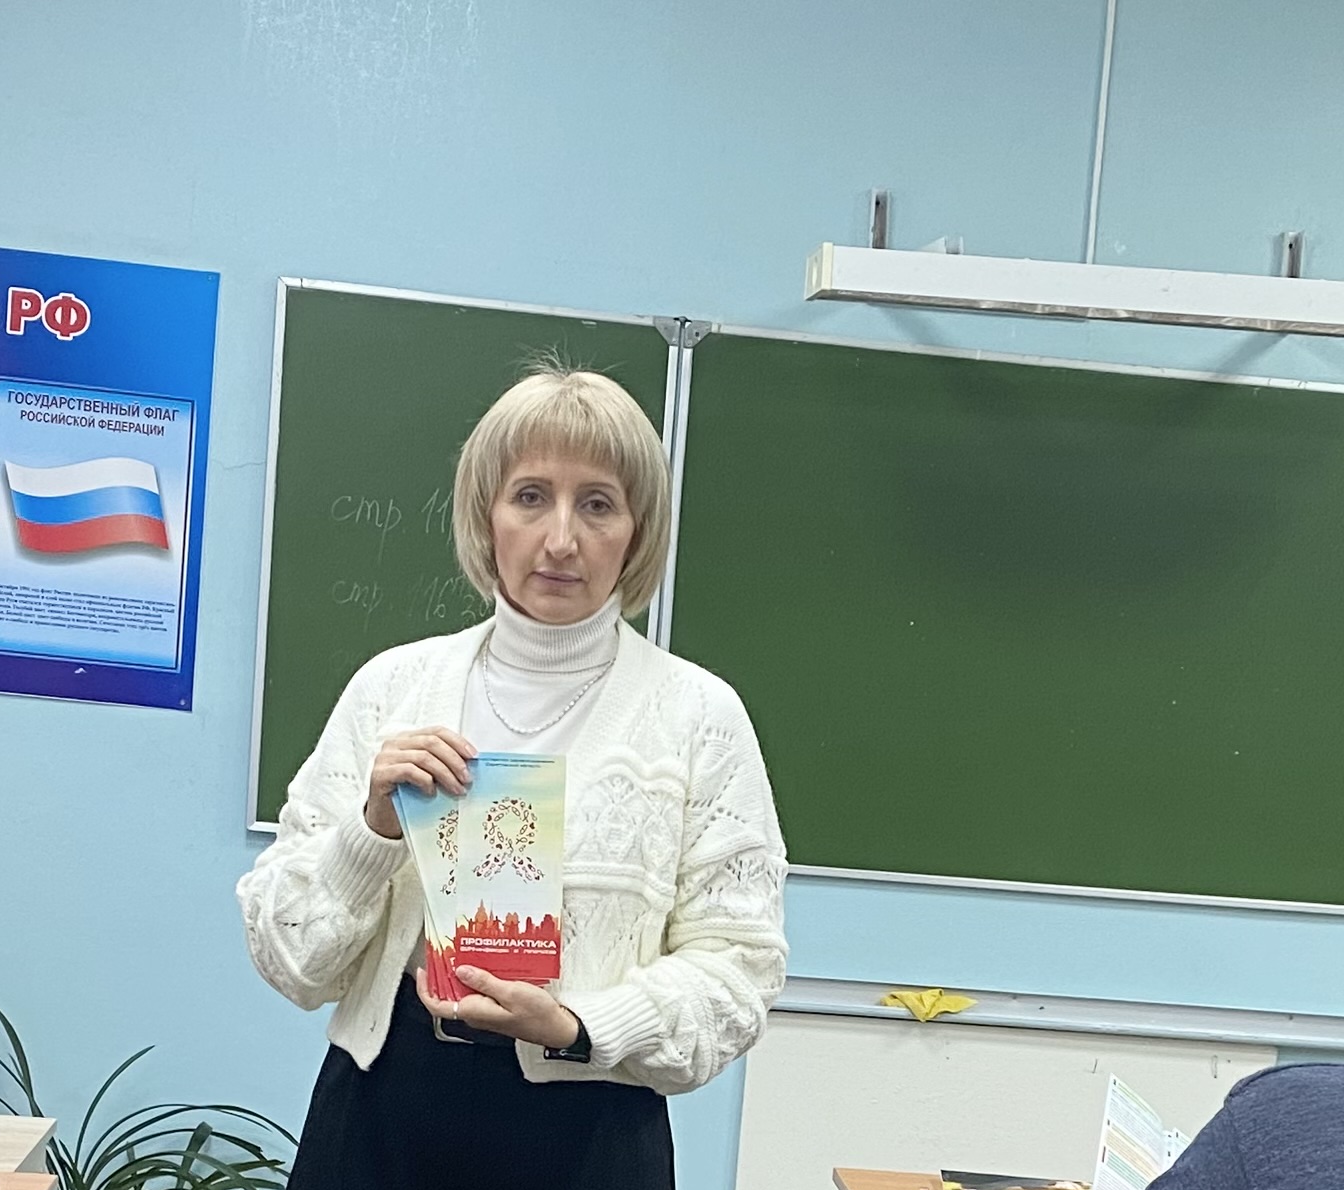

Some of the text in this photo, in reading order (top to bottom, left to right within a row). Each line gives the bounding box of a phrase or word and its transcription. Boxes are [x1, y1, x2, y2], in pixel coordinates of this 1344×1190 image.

[6, 286, 91, 340] РФ
[8, 390, 179, 422] ГОСУДАРСТВЕННЫЙ ФЛАГ
[20, 410, 164, 436] РОССИЙСКОЙ ФЕДЕРАЦИИ
[460, 937, 557, 949] ПРОФИЛАКТИКА
